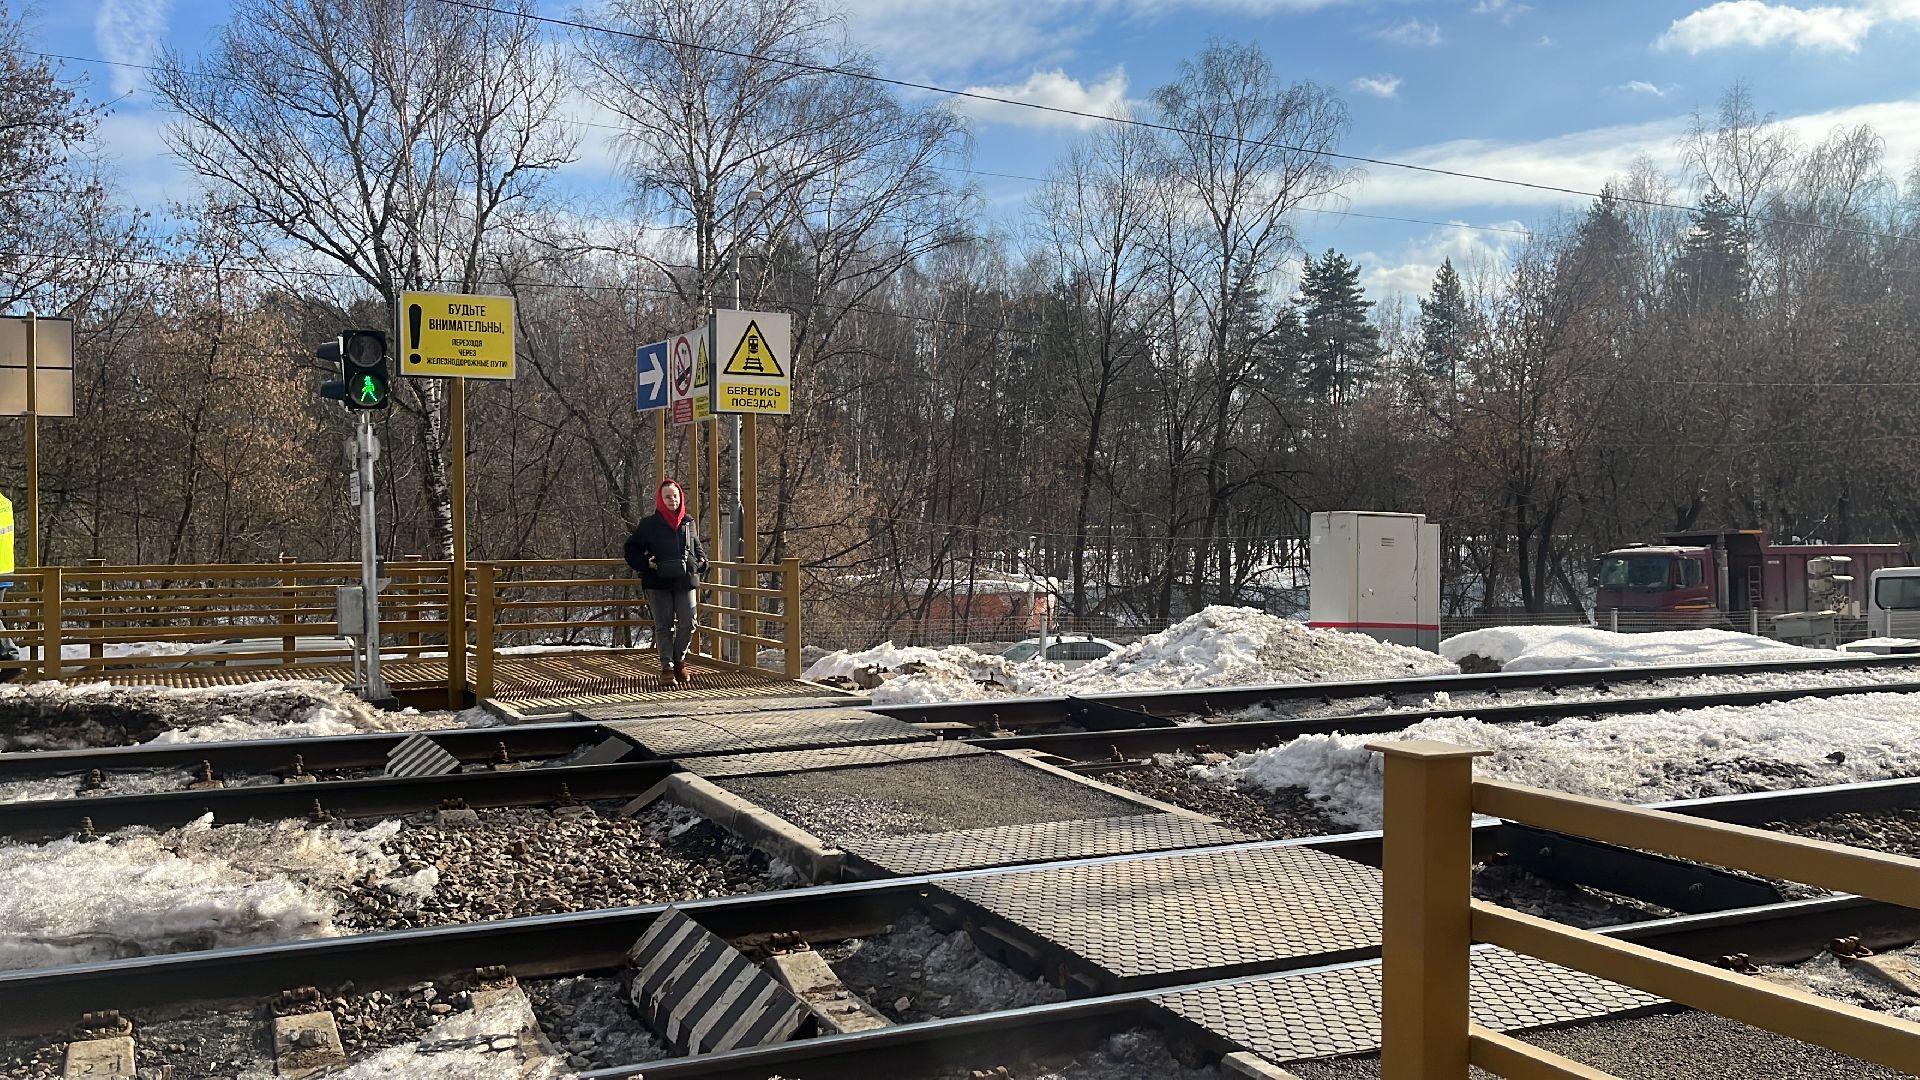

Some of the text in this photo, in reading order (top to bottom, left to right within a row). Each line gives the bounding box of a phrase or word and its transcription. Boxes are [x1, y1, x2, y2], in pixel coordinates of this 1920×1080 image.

[448, 304, 486, 316] БУДЬТЕ
[451, 338, 483, 347] ПЕРЕХОДЯ
[458, 349, 477, 357] ЧЕРЕЗ
[426, 357, 507, 368] ЖЕЛЕЗНОДОРОЖНЫЕ ПУТИ
[727, 386, 781, 397] БЕРЕГИСЬ
[731, 398, 776, 410] ПОЕЗДА!
